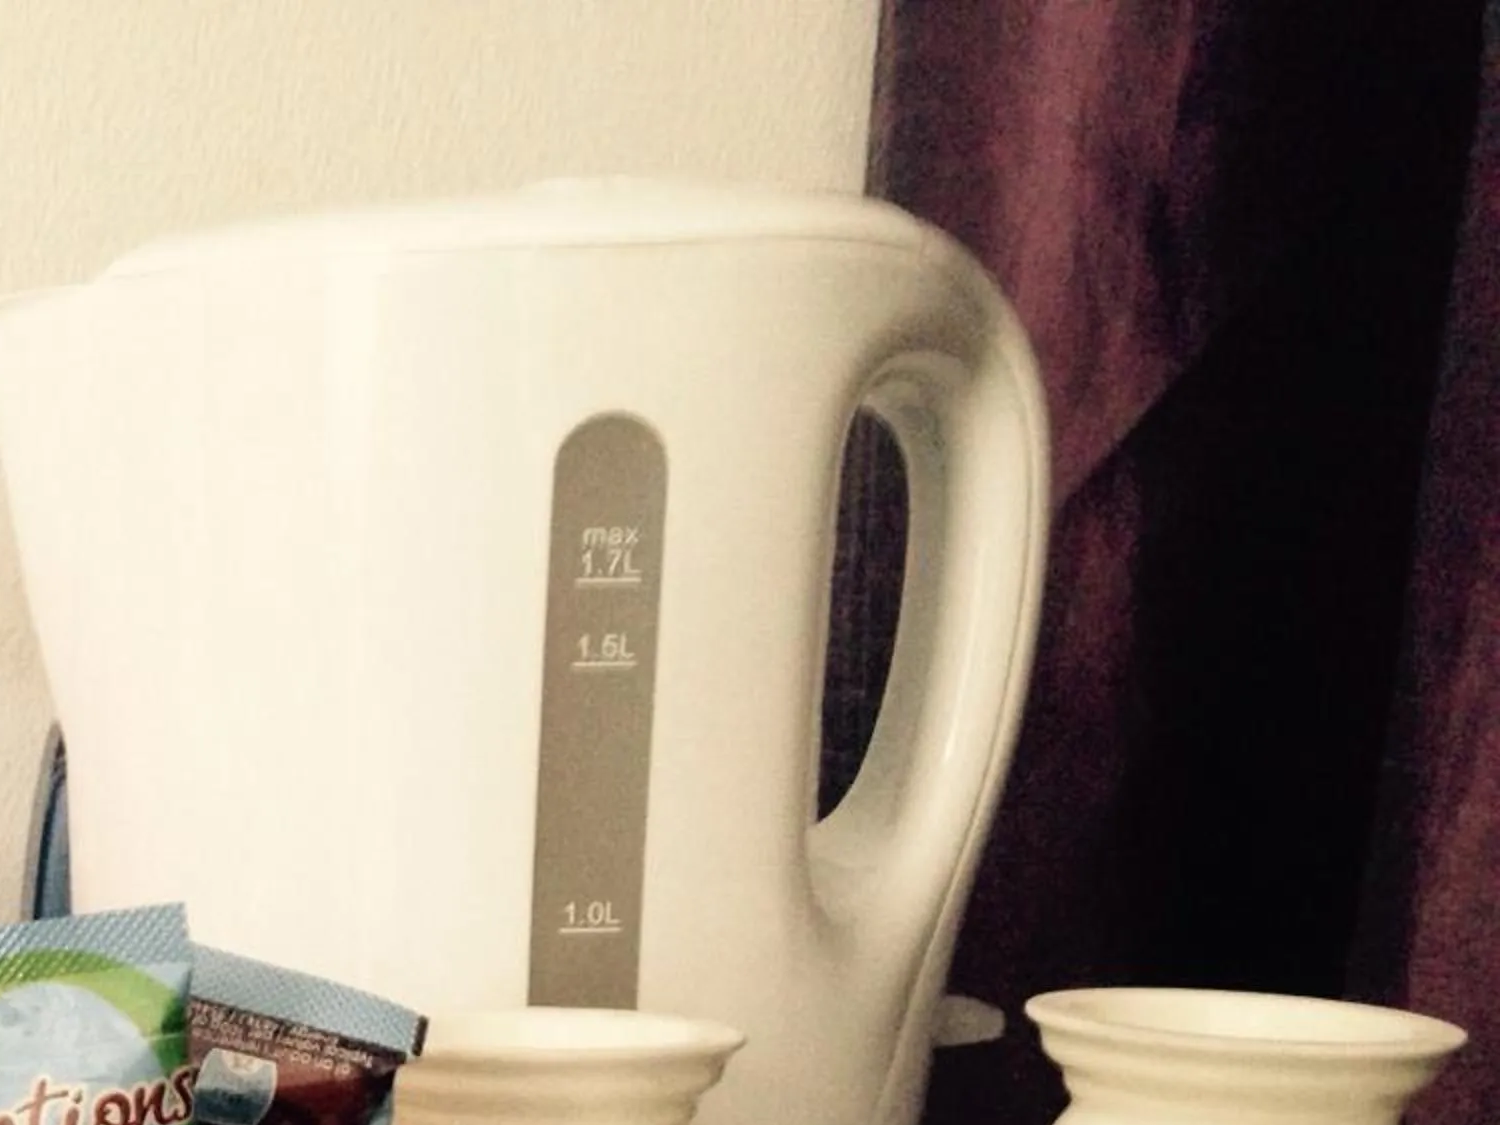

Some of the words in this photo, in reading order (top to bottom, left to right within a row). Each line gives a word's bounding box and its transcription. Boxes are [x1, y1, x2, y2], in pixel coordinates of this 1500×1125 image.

[582, 526, 639, 546] max
[581, 549, 643, 577] 1.7L
[563, 900, 623, 927] 1.0L
